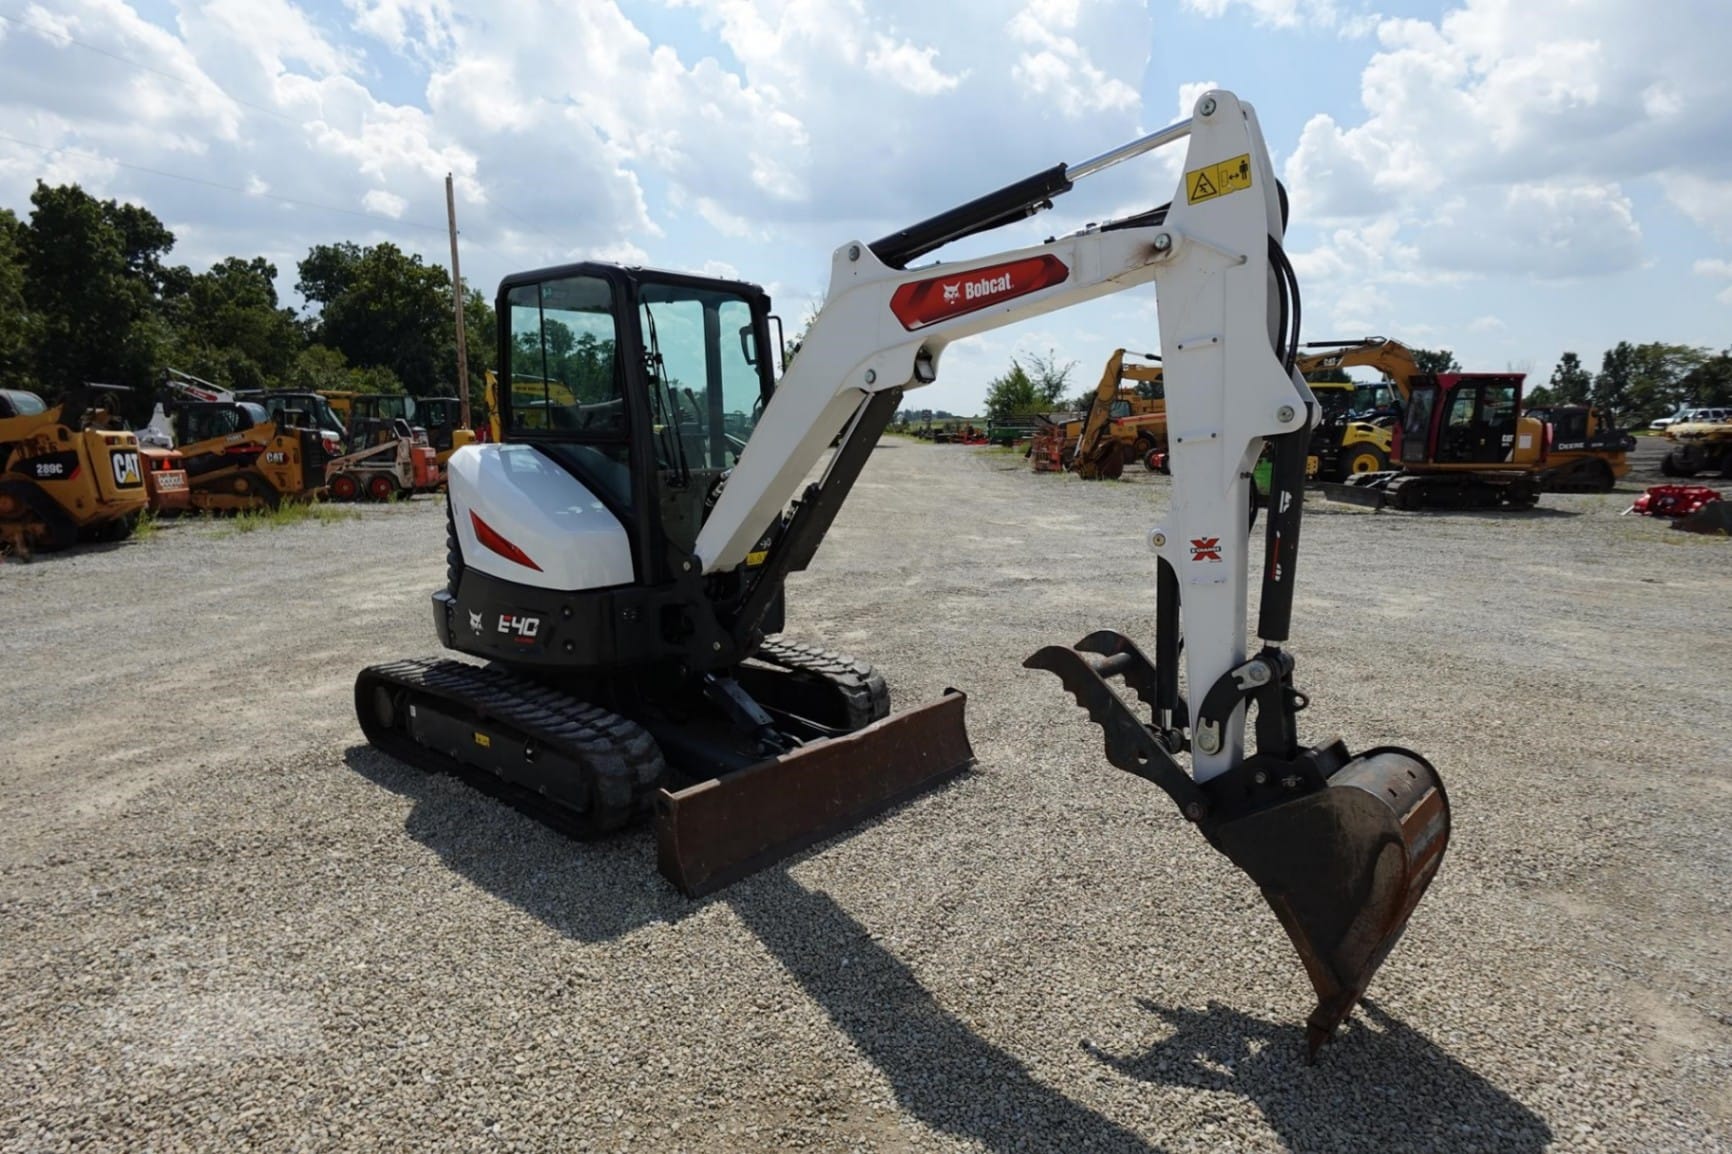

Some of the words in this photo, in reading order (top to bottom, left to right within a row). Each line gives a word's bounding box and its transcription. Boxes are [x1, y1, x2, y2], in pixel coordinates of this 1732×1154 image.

[965, 272, 1012, 300] Bobcat
[1324, 358, 1337, 366] CAT
[1558, 442, 1584, 451] DEERE
[266, 451, 285, 464] CAT
[36, 463, 63, 475] 289C
[113, 452, 141, 484] CAT
[497, 613, 540, 637] E40
